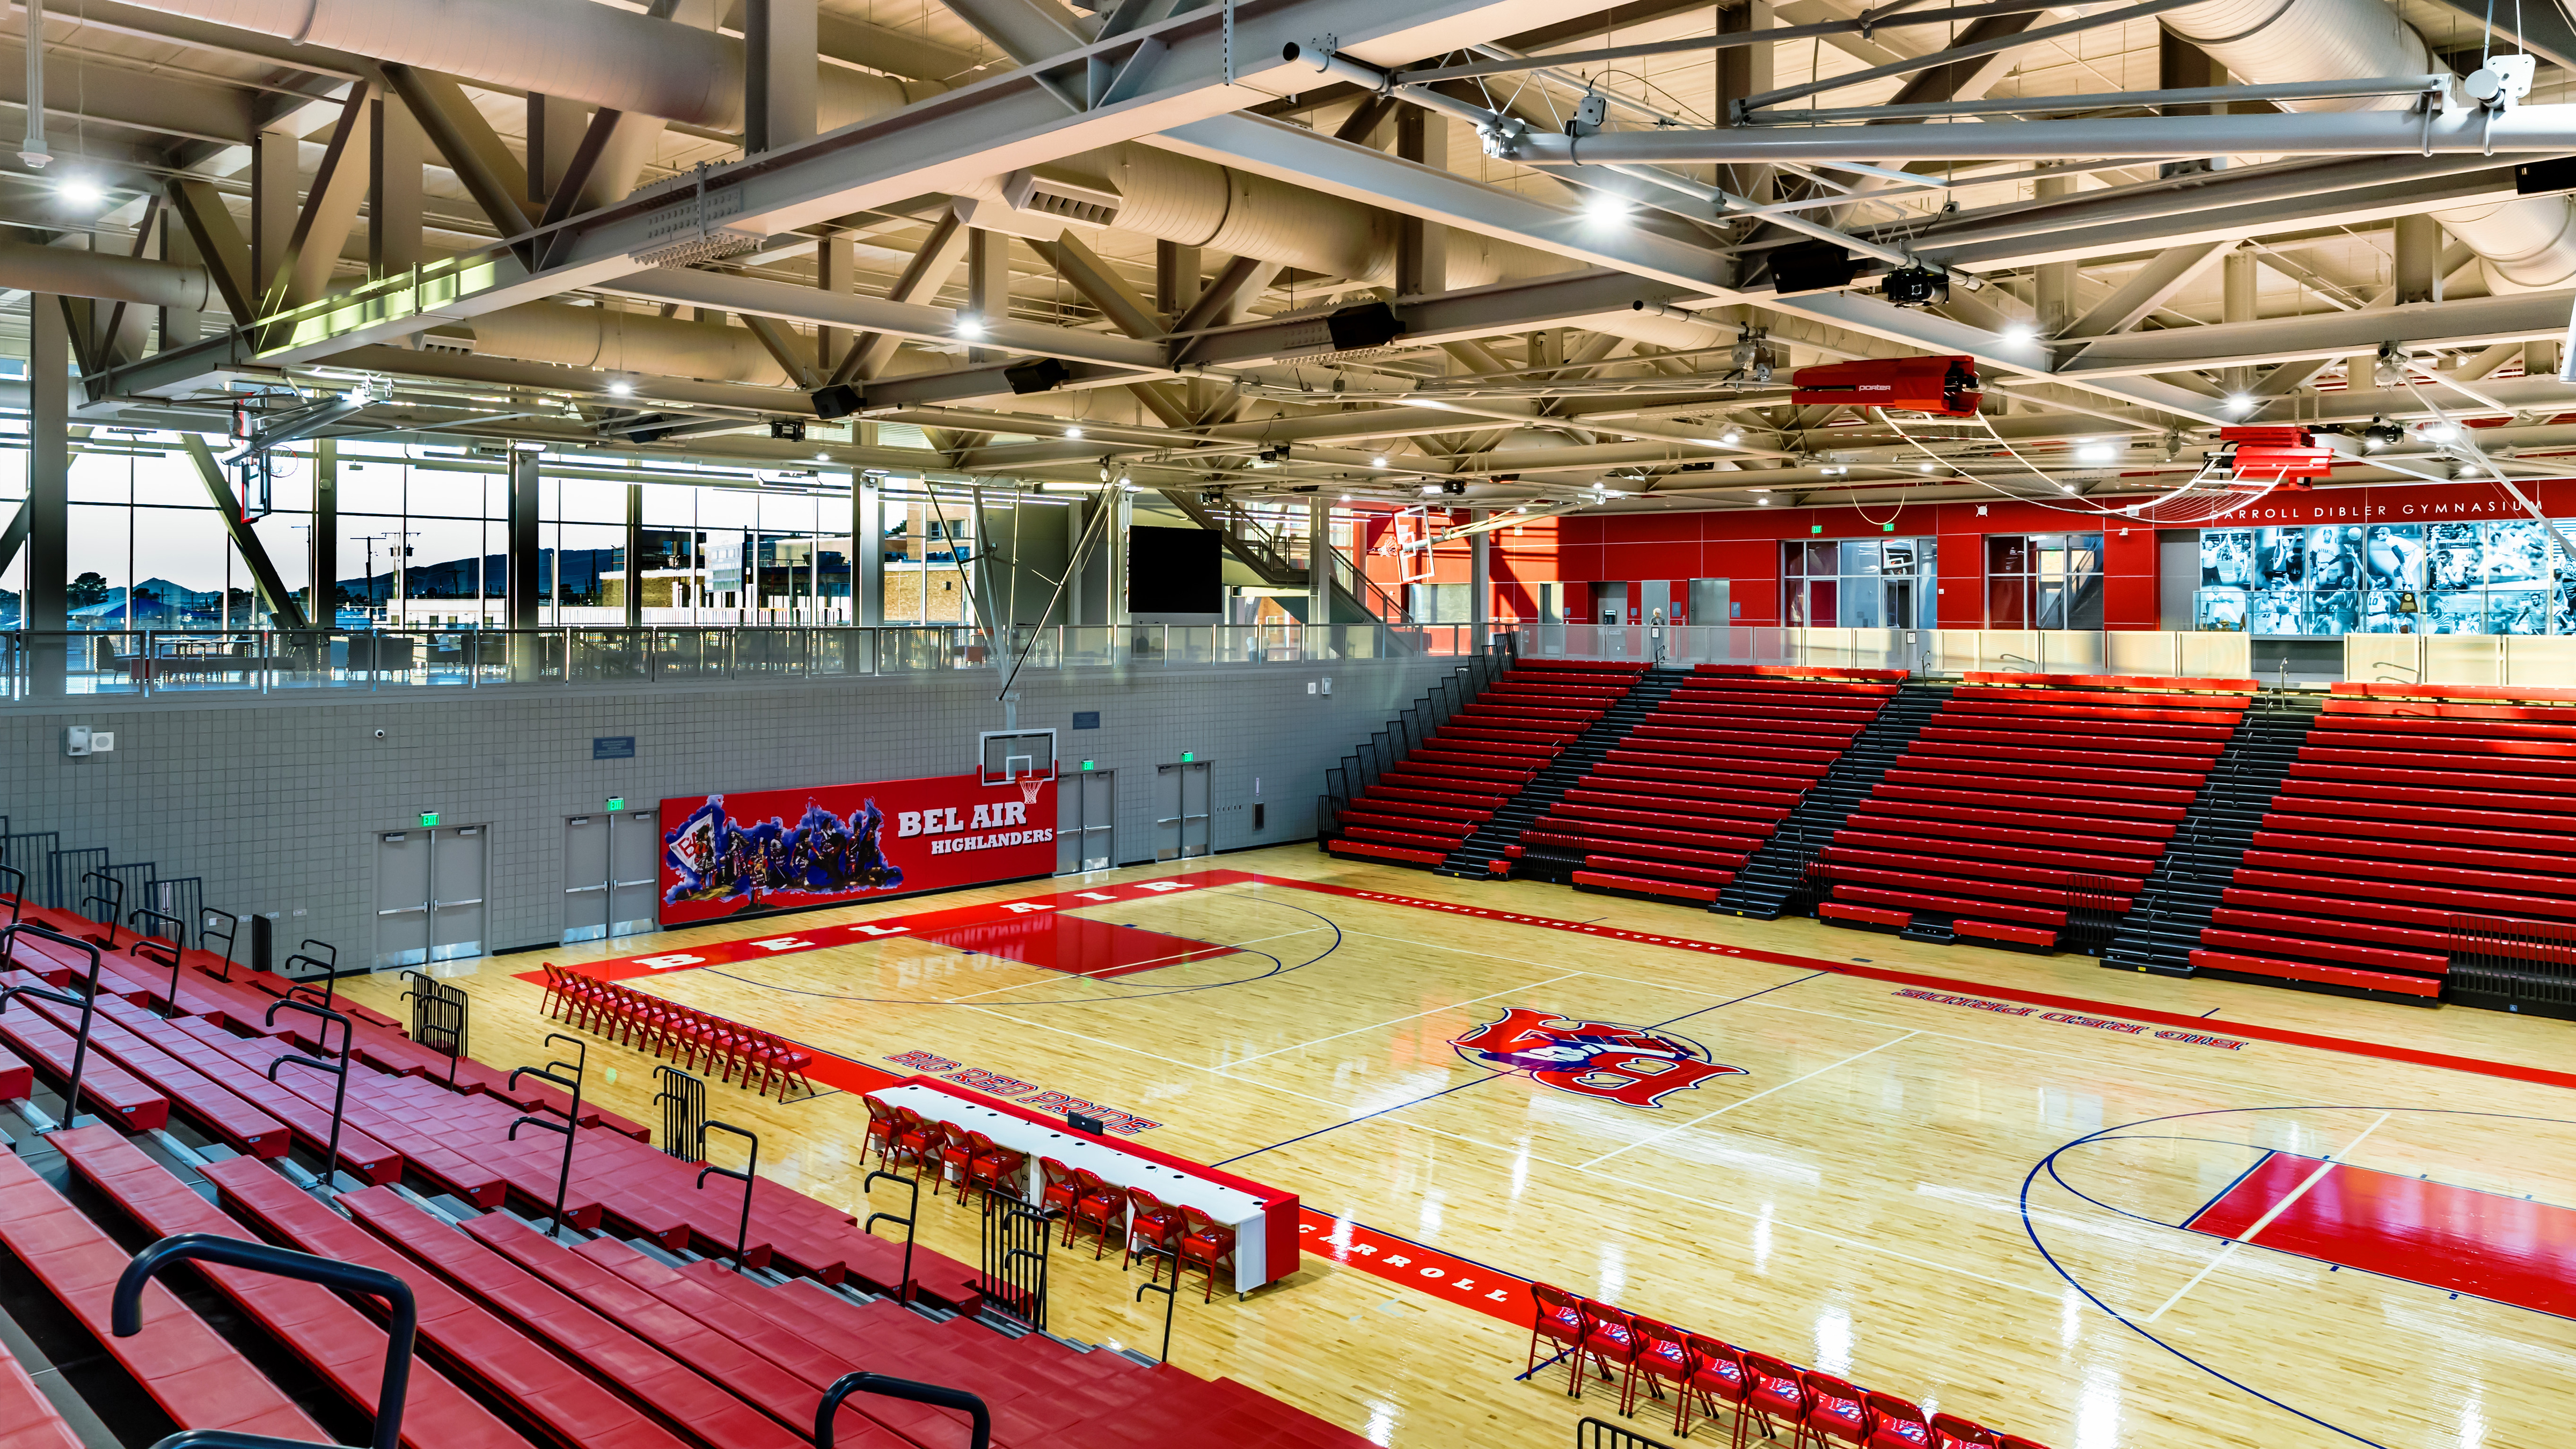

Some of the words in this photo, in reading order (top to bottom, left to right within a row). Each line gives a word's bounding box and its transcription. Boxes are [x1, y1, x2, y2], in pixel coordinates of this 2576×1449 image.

[2209, 508, 2299, 519] CARROLL
[2314, 506, 2386, 517] DIBLER
[2402, 501, 2543, 515] GYMNASIUM
[610, 801, 623, 810] EXIT
[423, 815, 437, 825] EXIT
[898, 808, 964, 837] BEL
[971, 802, 1027, 829] AIR
[931, 828, 1053, 855] HIGHLANDERS
[1891, 988, 2039, 1016] PRIDE
[2039, 1012, 2150, 1035] RED
[2155, 1030, 2250, 1051] BIG
[883, 1050, 962, 1073] BIG
[941, 1067, 1038, 1096] RED
[1299, 1224, 1509, 1302] CARROLL
